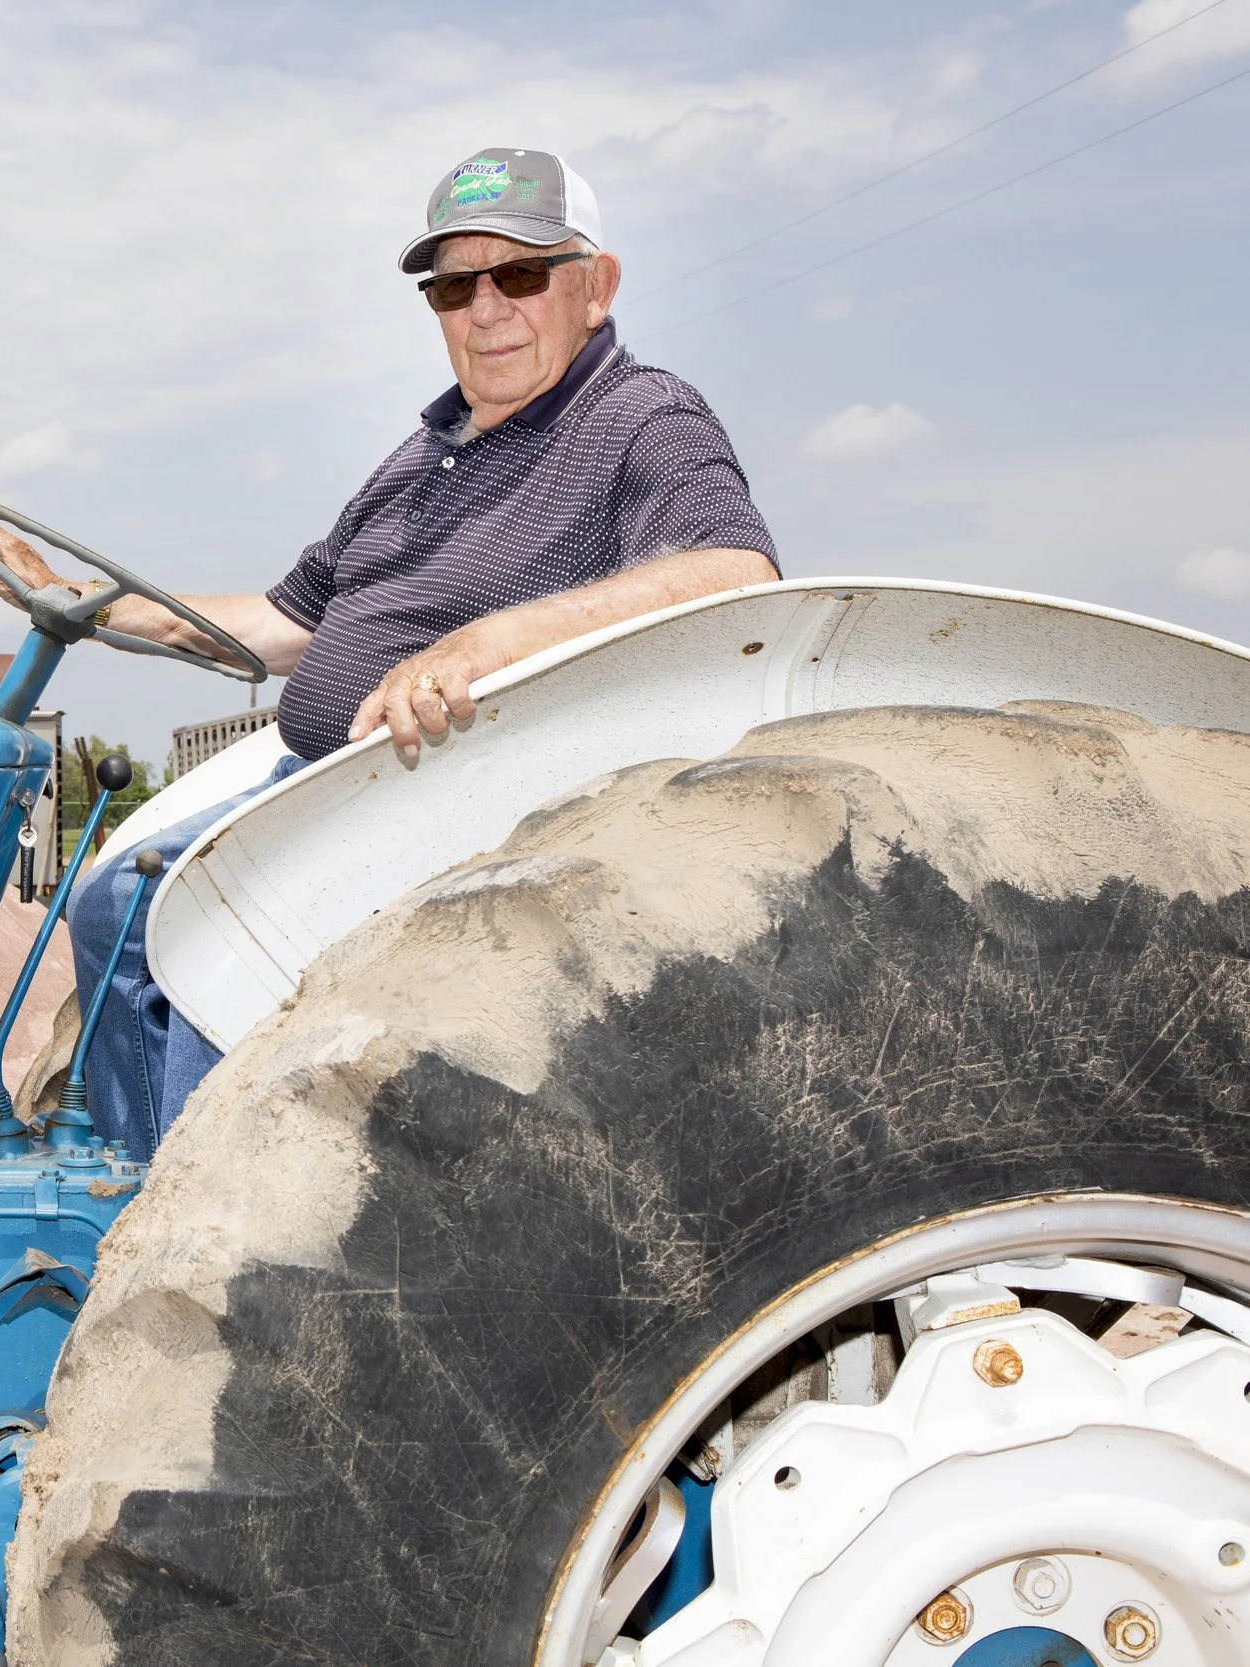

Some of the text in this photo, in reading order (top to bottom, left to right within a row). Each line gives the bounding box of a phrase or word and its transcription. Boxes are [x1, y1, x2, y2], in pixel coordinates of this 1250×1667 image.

[459, 163, 497, 175] TURNER
[450, 175, 512, 198] County Fair
